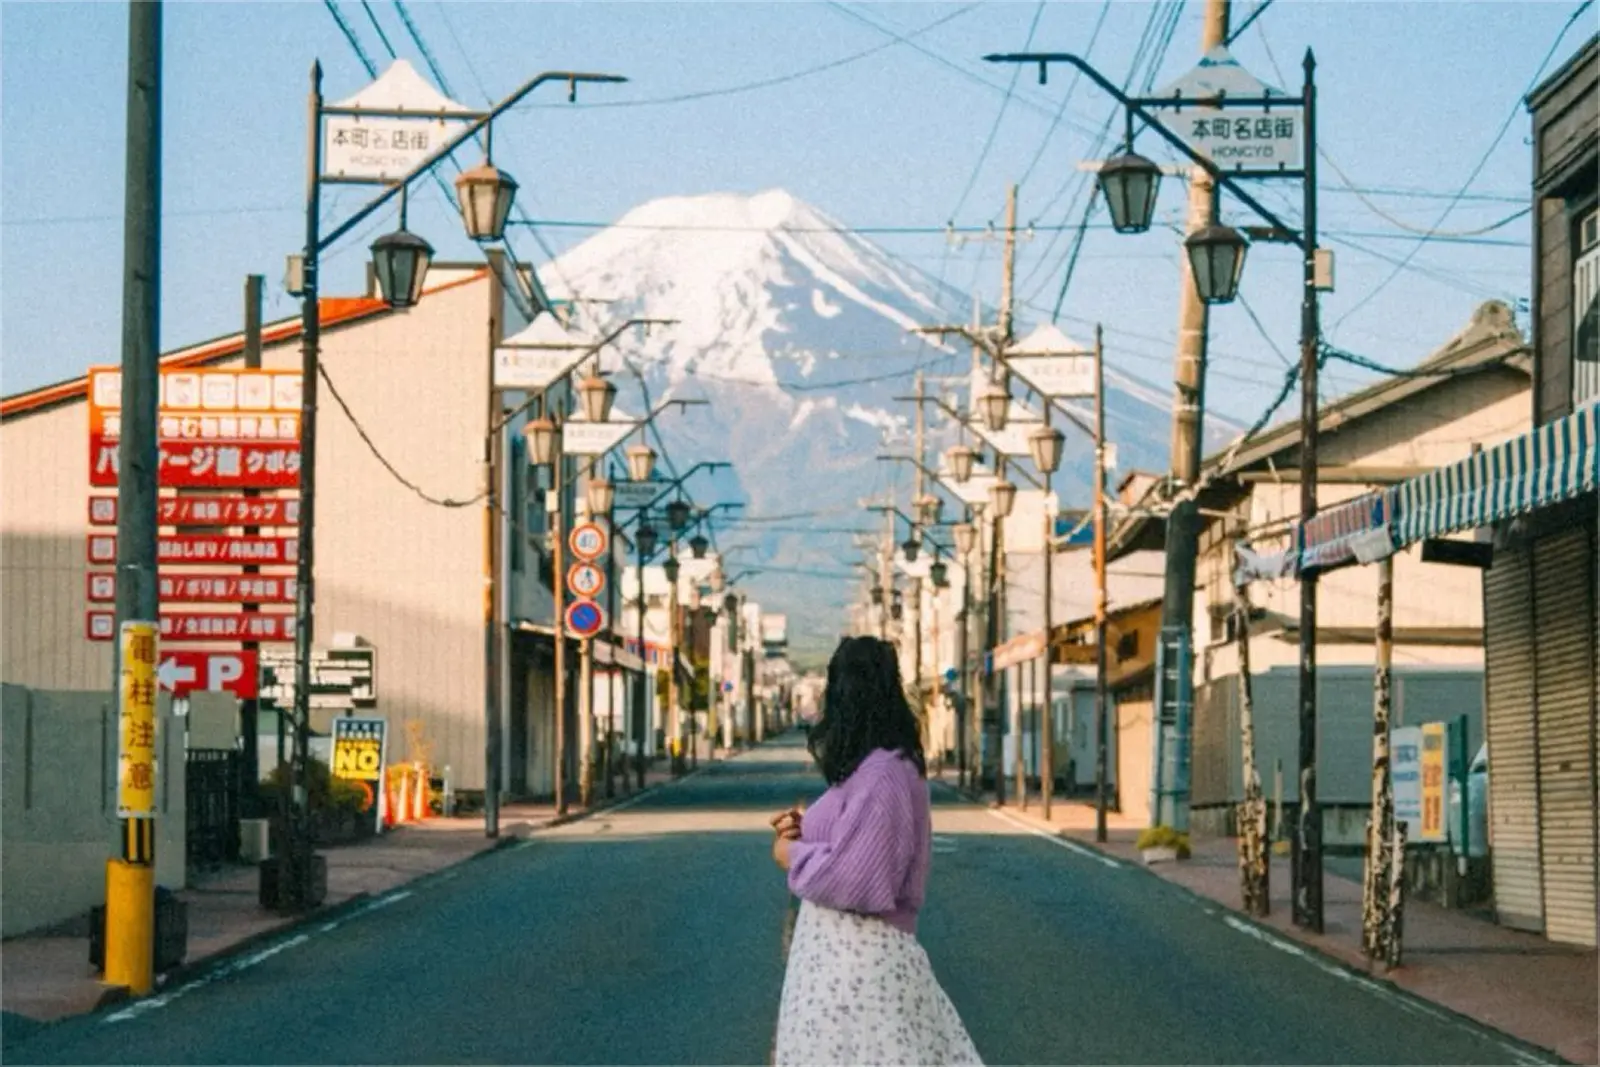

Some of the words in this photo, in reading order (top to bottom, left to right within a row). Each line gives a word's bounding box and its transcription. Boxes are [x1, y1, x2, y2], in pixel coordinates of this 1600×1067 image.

[1192, 117, 1294, 140] 本町名店街
[207, 656, 244, 692] P
[336, 748, 379, 770] NO
